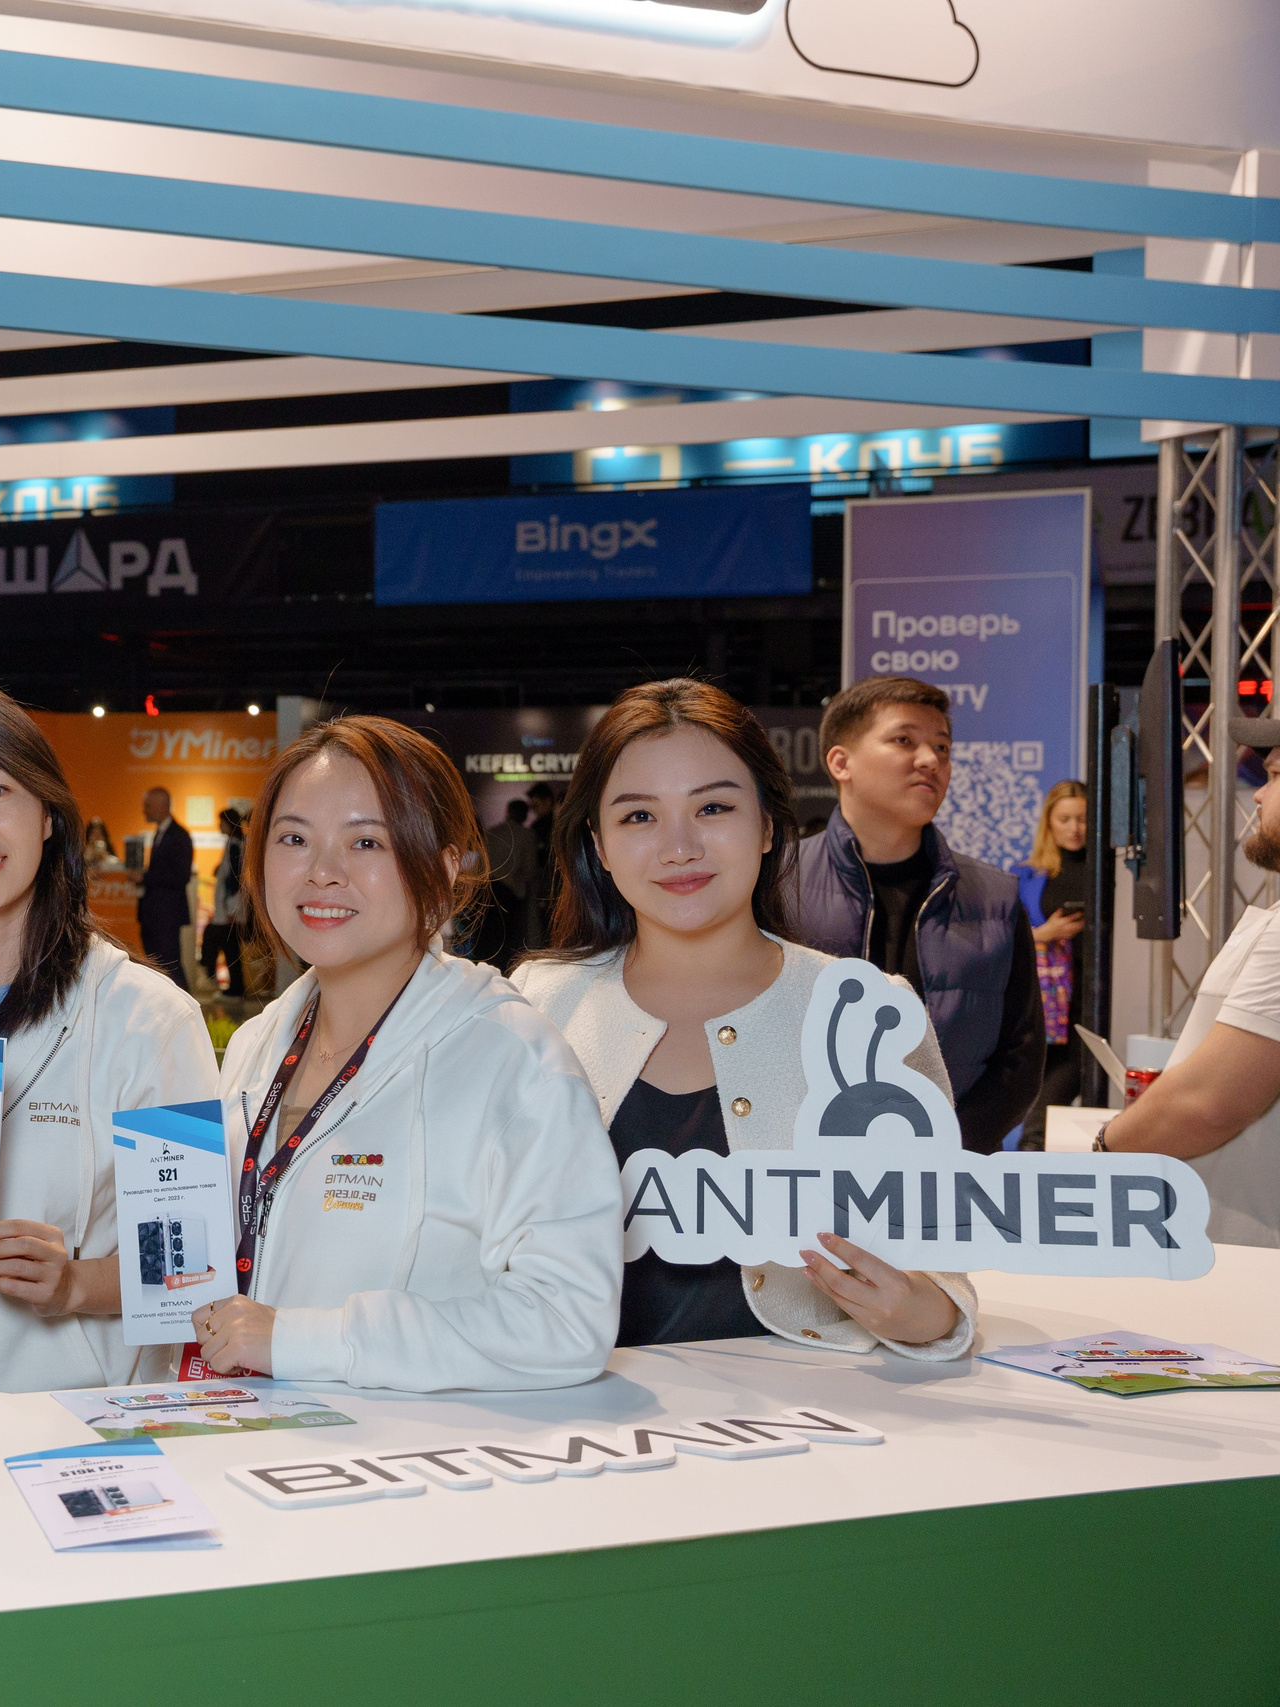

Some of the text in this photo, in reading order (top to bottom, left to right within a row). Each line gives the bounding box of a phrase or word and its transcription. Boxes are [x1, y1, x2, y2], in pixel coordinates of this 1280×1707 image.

[872, 610, 1020, 644] Проверь
[871, 649, 959, 673] свою
[310, 1064, 358, 1119] RUMINERS
[253, 1081, 283, 1138] RUMINERS
[150, 1154, 185, 1164] ANTMINER
[330, 1153, 384, 1166] TICTACC
[158, 1168, 178, 1182] S21
[324, 1173, 384, 1188] BITMAIN
[323, 1189, 377, 1202] 2023.10.28
[624, 1166, 1181, 1250] ANTMINER
[160, 1300, 193, 1308] BITMAIN
[246, 1410, 860, 1495] BITMAIN
[59, 1468, 96, 1478] S19k
[99, 1464, 124, 1472] Pro
